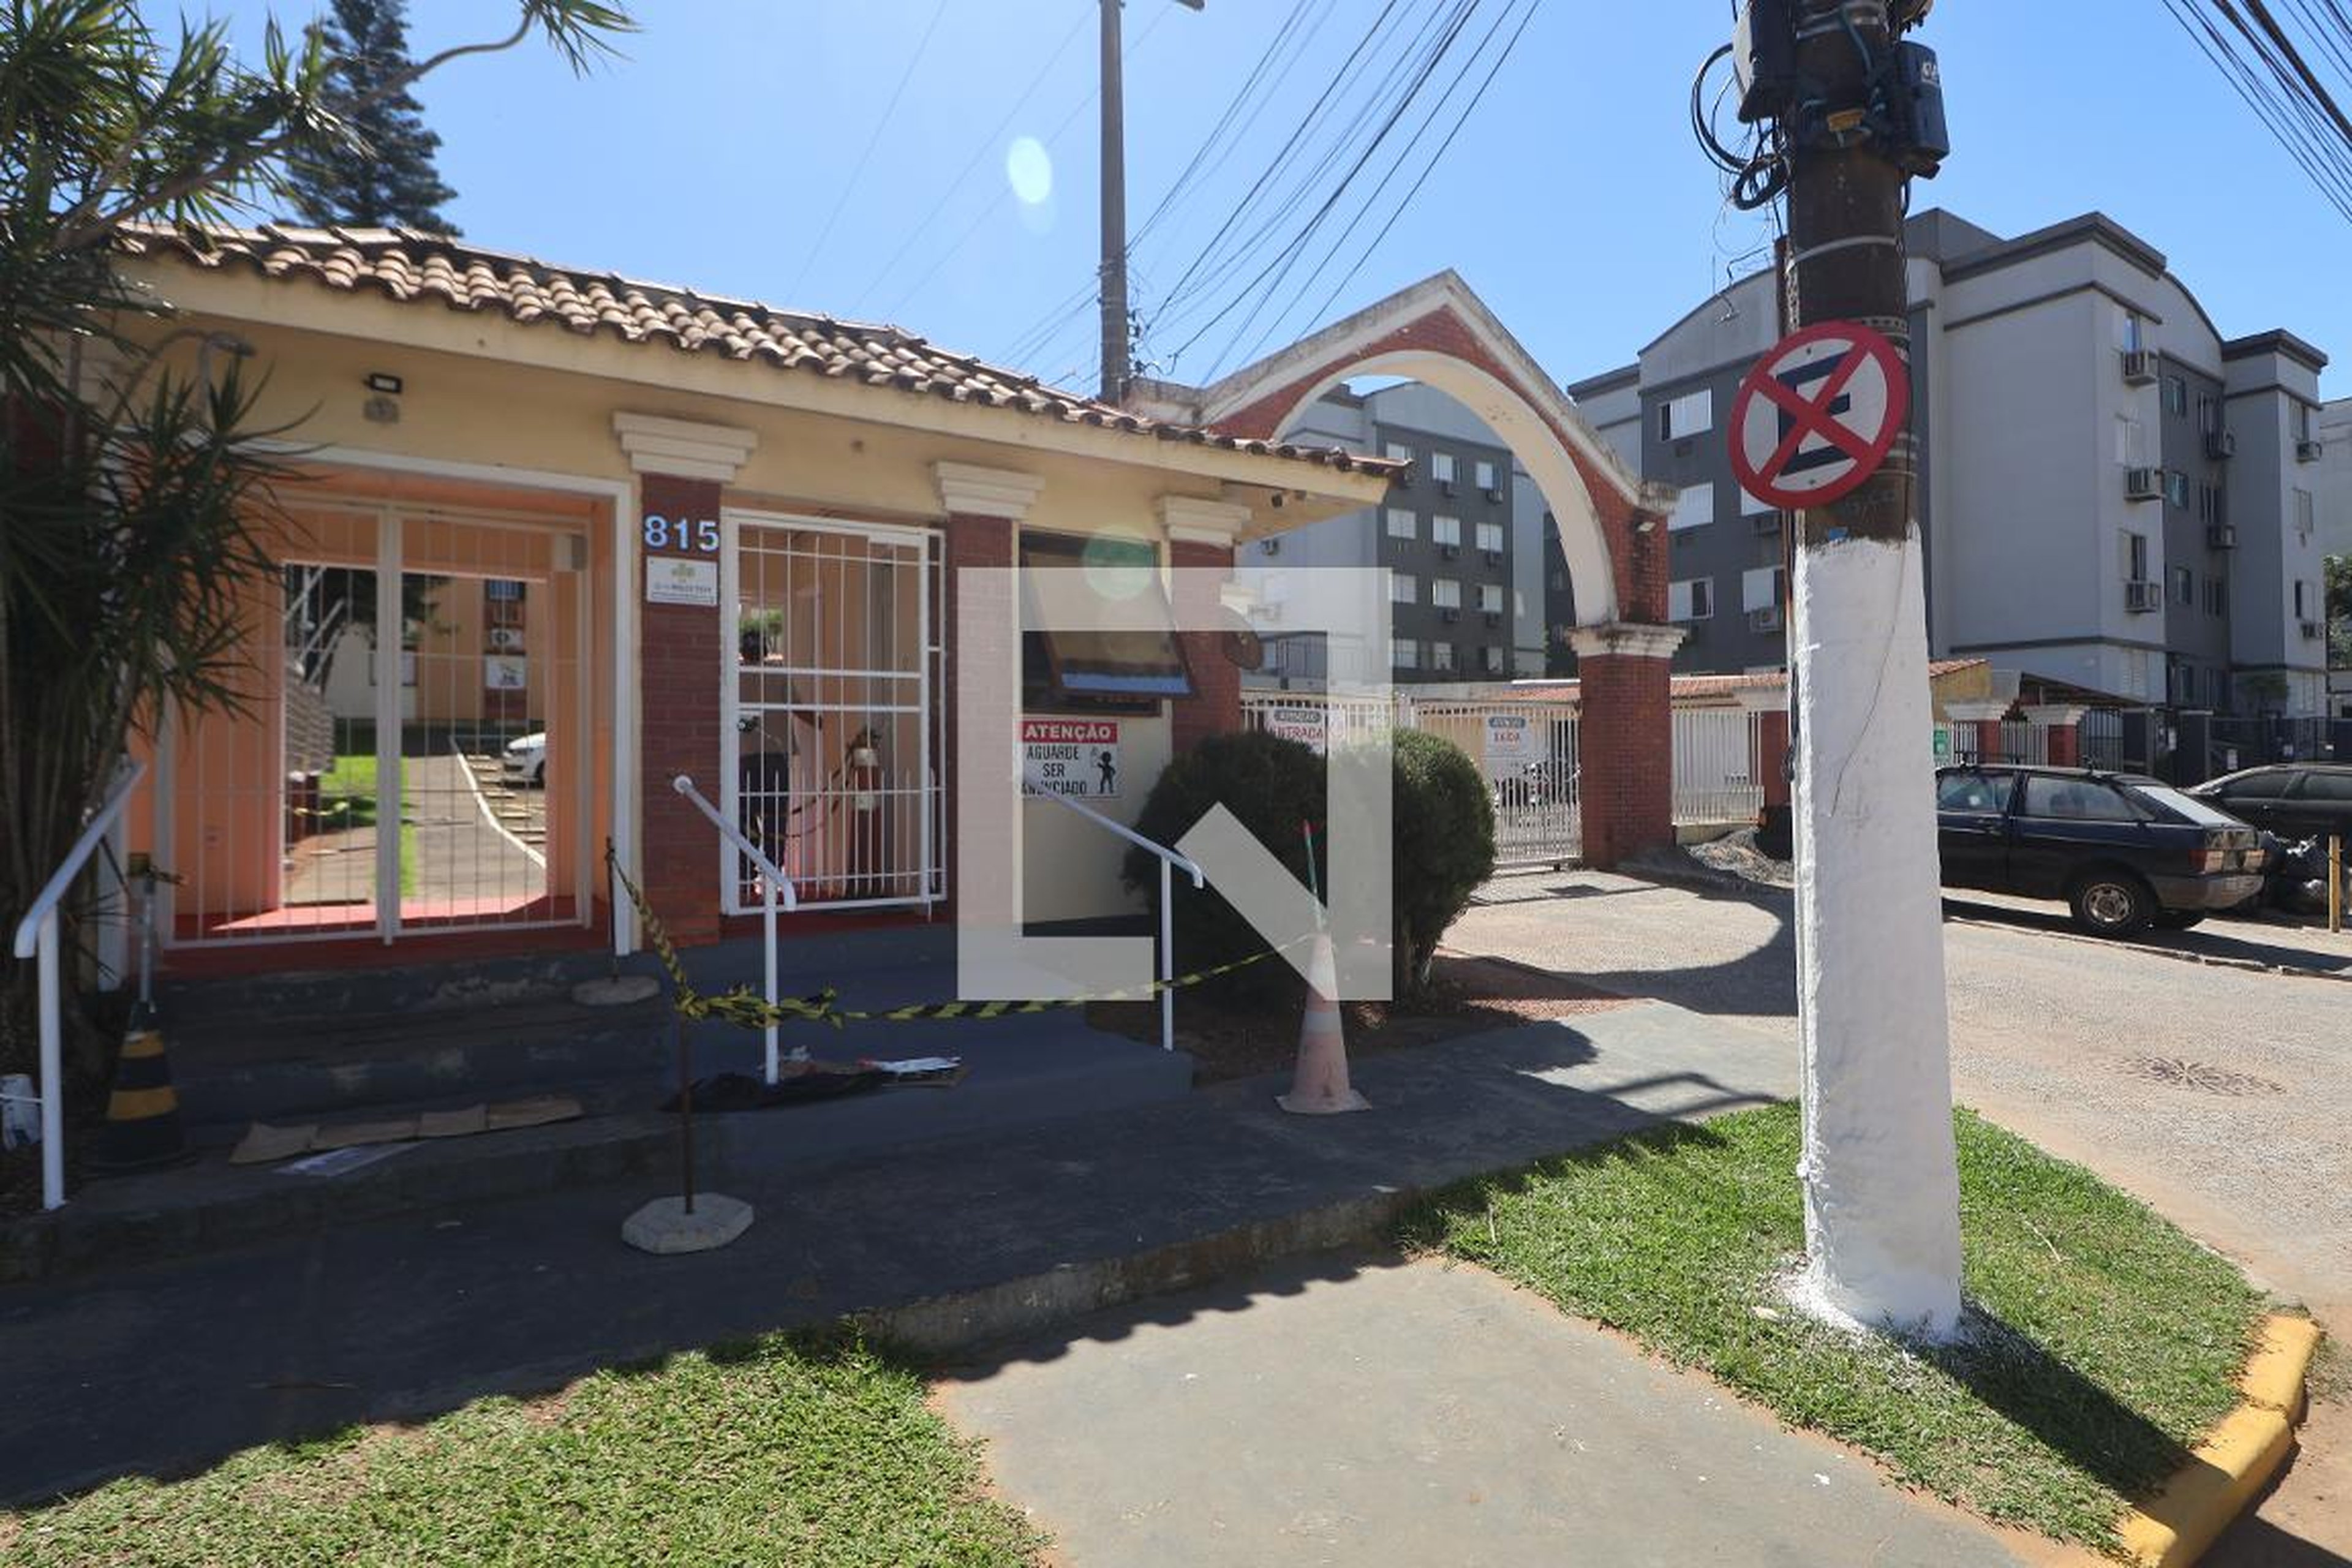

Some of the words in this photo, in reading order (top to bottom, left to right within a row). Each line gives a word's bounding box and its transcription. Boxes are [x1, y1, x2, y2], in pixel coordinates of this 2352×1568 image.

[644, 515, 720, 551] 815
[1025, 723, 1111, 741] ATENÇÃO
[1027, 745, 1079, 760] AGUARDE
[1042, 763, 1065, 778] SER
